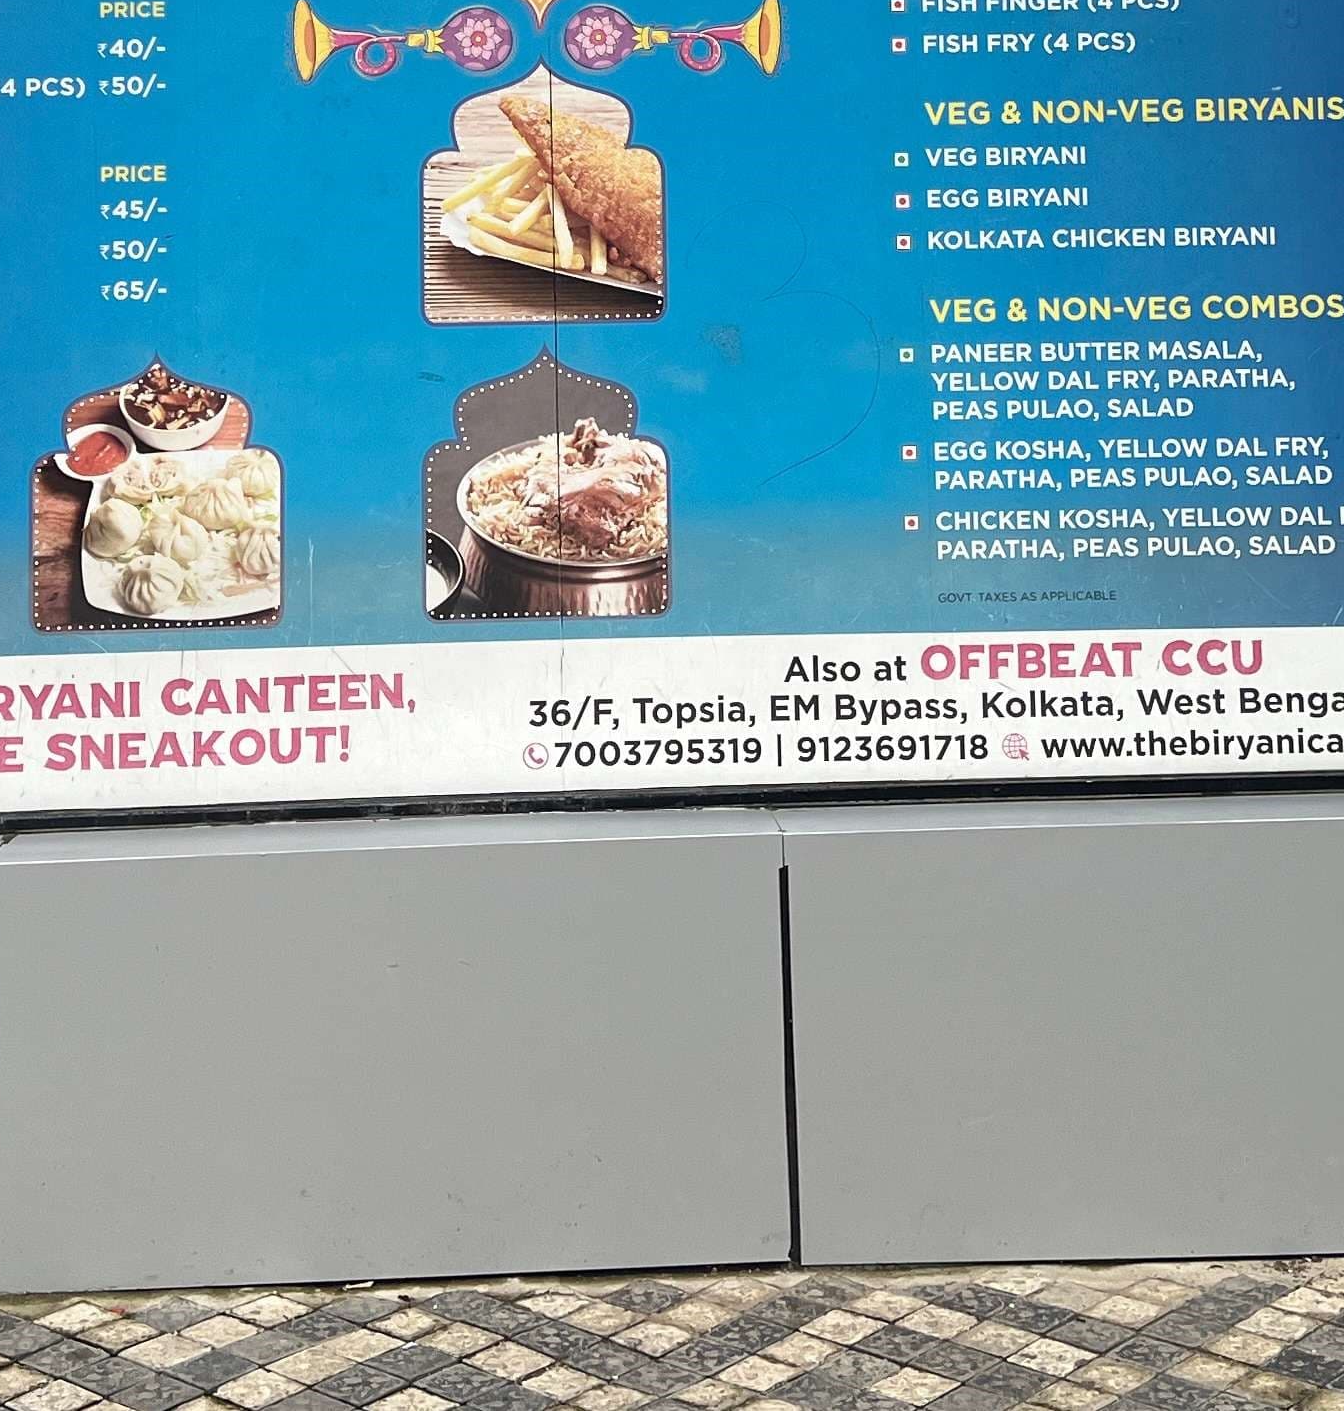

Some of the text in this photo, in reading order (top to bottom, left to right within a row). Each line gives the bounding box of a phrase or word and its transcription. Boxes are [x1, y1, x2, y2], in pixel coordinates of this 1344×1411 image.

[99, 0, 166, 19] PRICE
[923, 32, 1136, 55] FISH FRY (4 PCS)
[25, 76, 86, 99] PCS)
[924, 100, 991, 126] VEG
[1000, 100, 1022, 125] &
[1032, 98, 1184, 124] NON-VEG
[925, 145, 1086, 167] VEG BIRYANI
[100, 164, 167, 183] PRICE
[926, 187, 1088, 209] EGG BIRYANI
[927, 226, 1276, 250] KOLKATA CHICKEN BIRYANI
[929, 293, 1344, 323] VEG & NON-VEG COMBOS
[931, 339, 1263, 364] PANEER BUTTER MASALA,
[930, 368, 1296, 393] YELLOW DAL FRY, PARATHA,
[932, 397, 1194, 422] PEAS PULAO, SALAD
[933, 436, 1329, 463] EGG KOSHA, YELLOW DAL FRY,
[935, 465, 1333, 492] PARATHA, PEAS PULAO, SALAD
[935, 509, 1050, 531] CHICKEN
[1059, 508, 1155, 532] KOSHA,
[1162, 506, 1272, 528] YELLOW
[1280, 506, 1333, 526] DAL
[937, 534, 1336, 562] PARATHA, PEAS PULAO, SALAD
[978, 591, 1018, 603] TAXES
[1019, 591, 1038, 602] AS
[1040, 589, 1117, 602] APPLICABLE
[783, 639, 1263, 683] Also at OFFBEAT CCU
[160, 672, 416, 716] CANTEEN,
[528, 695, 620, 731] 36/F,
[632, 694, 756, 729] Topsia,
[770, 694, 820, 722] EM
[835, 693, 968, 726] Bypass,
[981, 689, 1124, 722] Kolkata,
[1136, 688, 1226, 716] West
[43, 724, 350, 772] SNEAKOUT!
[554, 737, 762, 768] 7003795319
[797, 734, 989, 763] 9123691718
